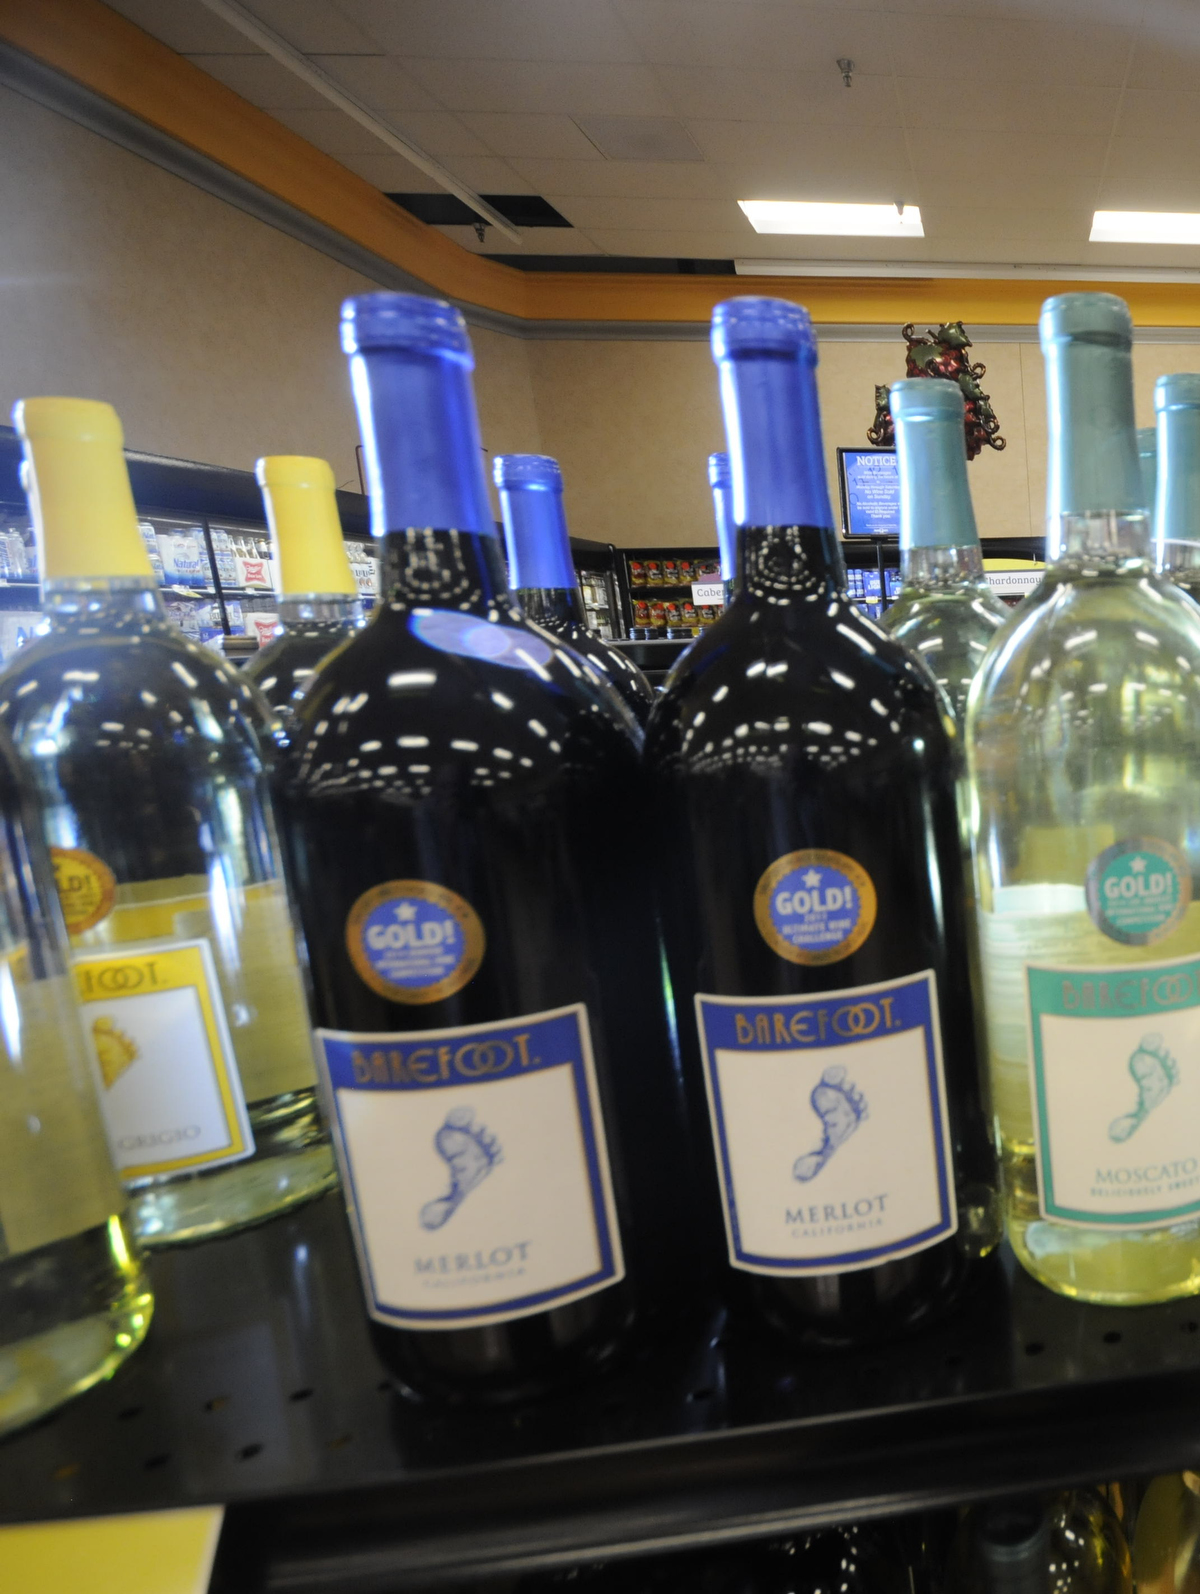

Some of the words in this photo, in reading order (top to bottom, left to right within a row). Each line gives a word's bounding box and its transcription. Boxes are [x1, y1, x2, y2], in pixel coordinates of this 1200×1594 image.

[856, 455, 897, 466] NOTICE
[985, 576, 1041, 586] hardonnay
[1104, 871, 1173, 899] GOLD!
[774, 885, 853, 916] GOLD!
[366, 918, 457, 951] GOLD!
[735, 997, 895, 1045] BAREFOOT
[352, 1033, 533, 1084] BAREFOOT
[117, 1124, 201, 1152] GRIGIO
[1094, 1156, 1199, 1186] MOSCATO
[783, 1192, 889, 1226] MERLOT
[791, 1217, 883, 1239] CALIFORNIA
[413, 1240, 534, 1276] MERLOT
